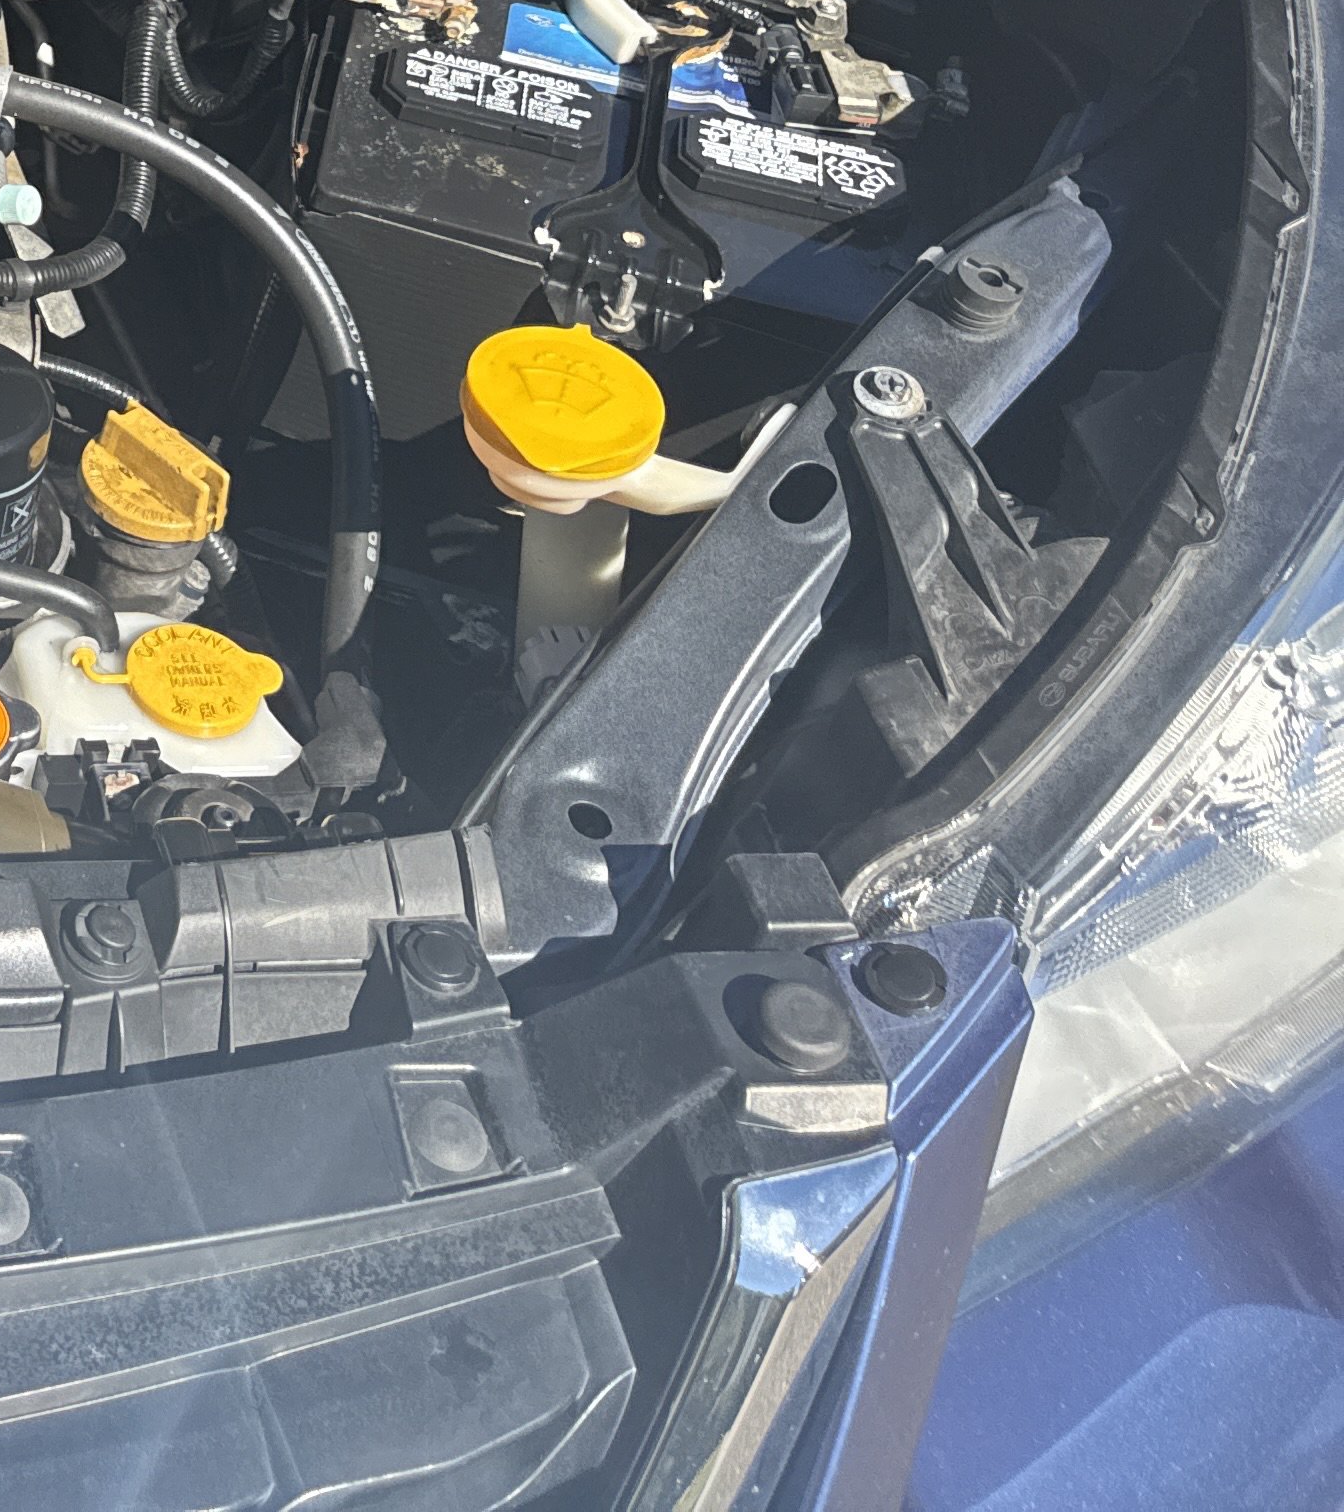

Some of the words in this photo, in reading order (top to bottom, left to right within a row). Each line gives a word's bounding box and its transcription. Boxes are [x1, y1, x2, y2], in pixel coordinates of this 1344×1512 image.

[433, 51, 502, 74] DANGER
[517, 71, 580, 93] POISON
[133, 626, 235, 658] COOLANT
[170, 653, 200, 664] SEE
[169, 675, 227, 688] MANUAL
